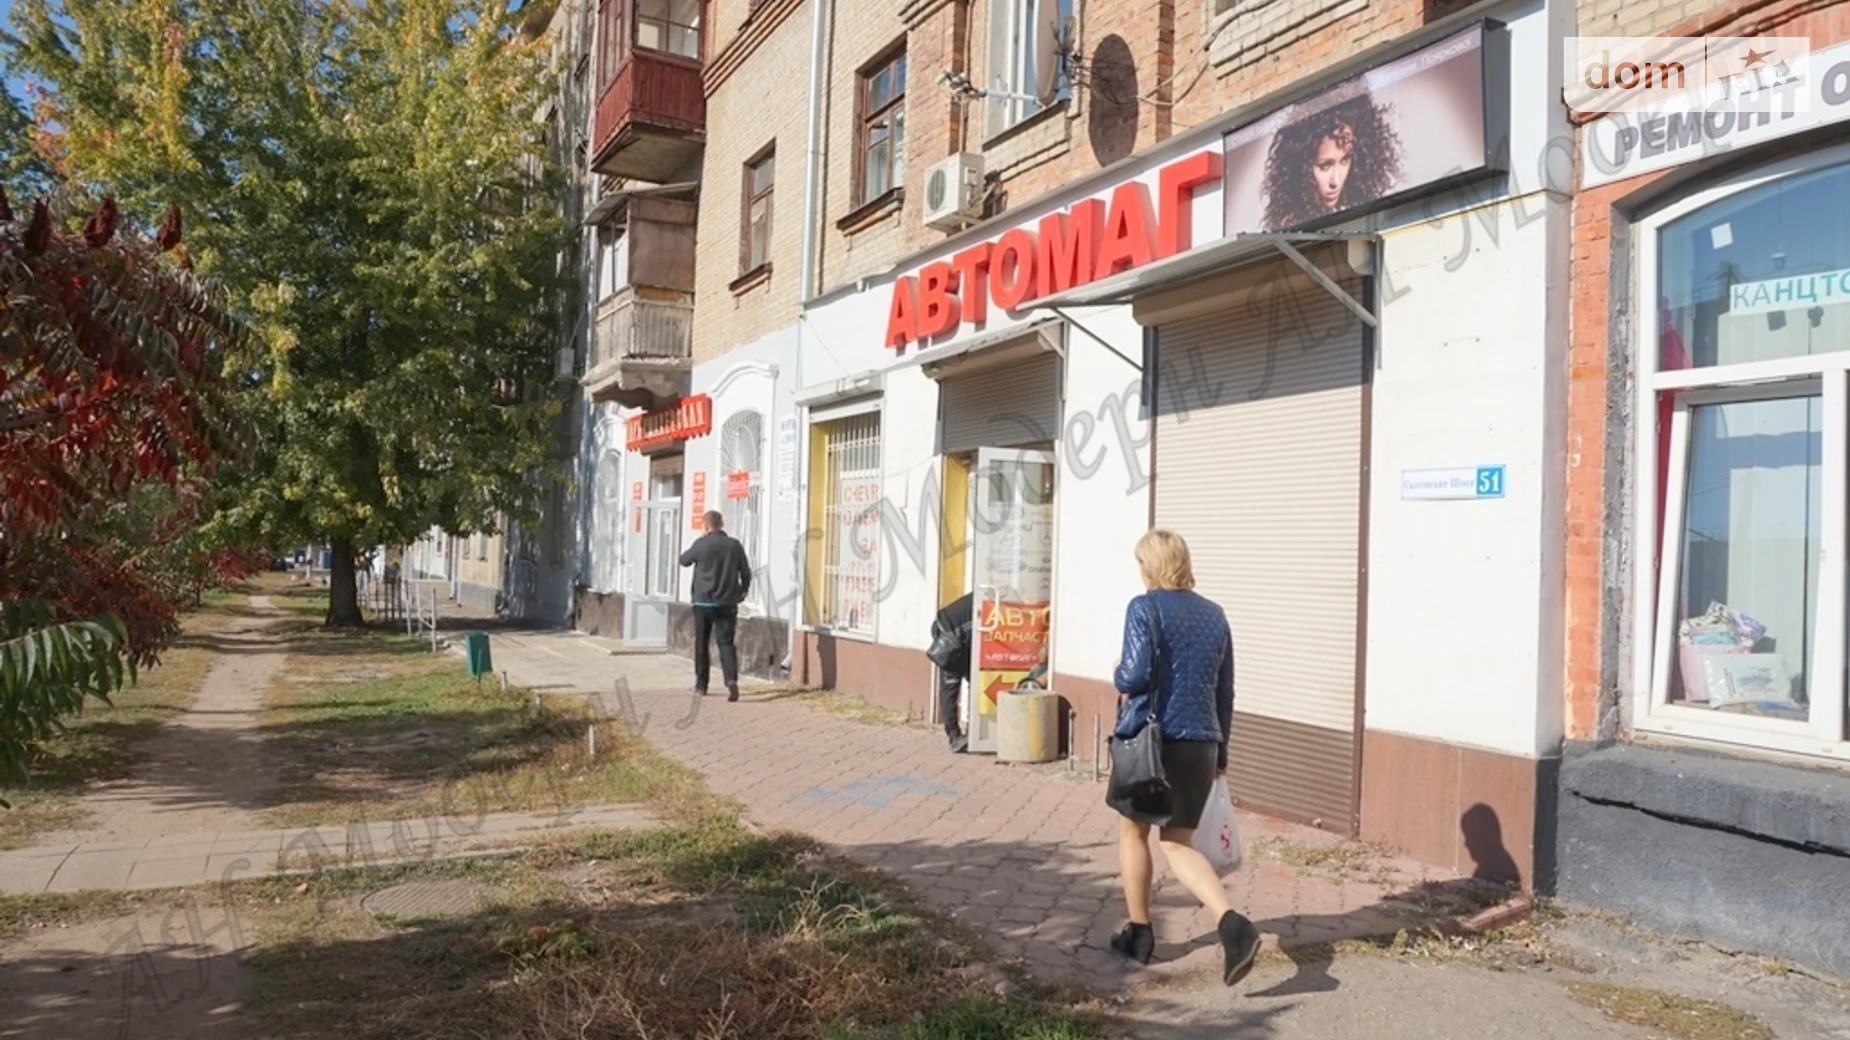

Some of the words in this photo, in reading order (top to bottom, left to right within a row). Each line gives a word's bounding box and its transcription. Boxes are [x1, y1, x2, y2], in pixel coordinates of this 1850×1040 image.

[1613, 77, 1806, 167] РЕМОНТ
[884, 150, 1222, 347] АВТОМАГ
[1479, 470, 1501, 493] 51
